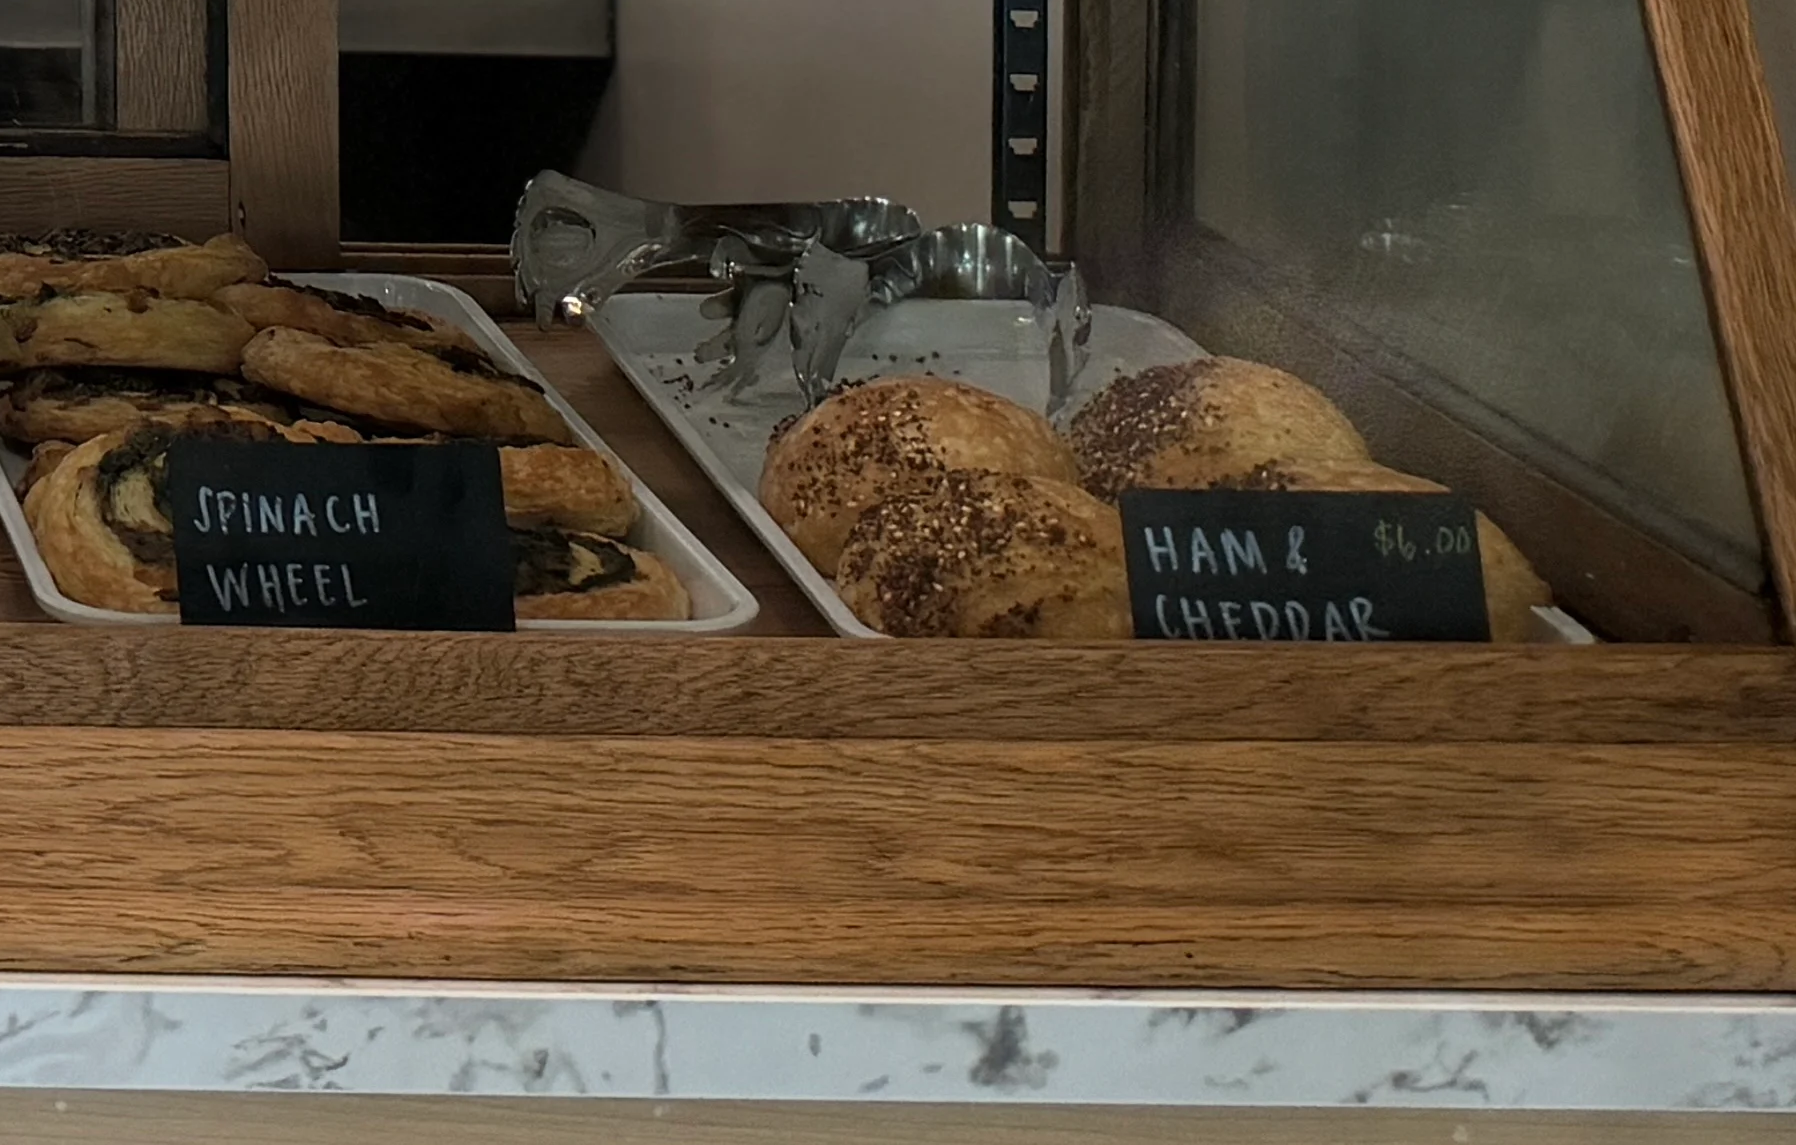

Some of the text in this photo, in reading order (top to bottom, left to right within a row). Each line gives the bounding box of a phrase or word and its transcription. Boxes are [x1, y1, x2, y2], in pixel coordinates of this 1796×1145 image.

[193, 485, 381, 537] SPINACH
[1144, 524, 1308, 576] HAM &
[1372, 520, 1474, 561] $6.00
[206, 562, 368, 613] WHEEL
[1156, 593, 1391, 643] CHEDDAR
